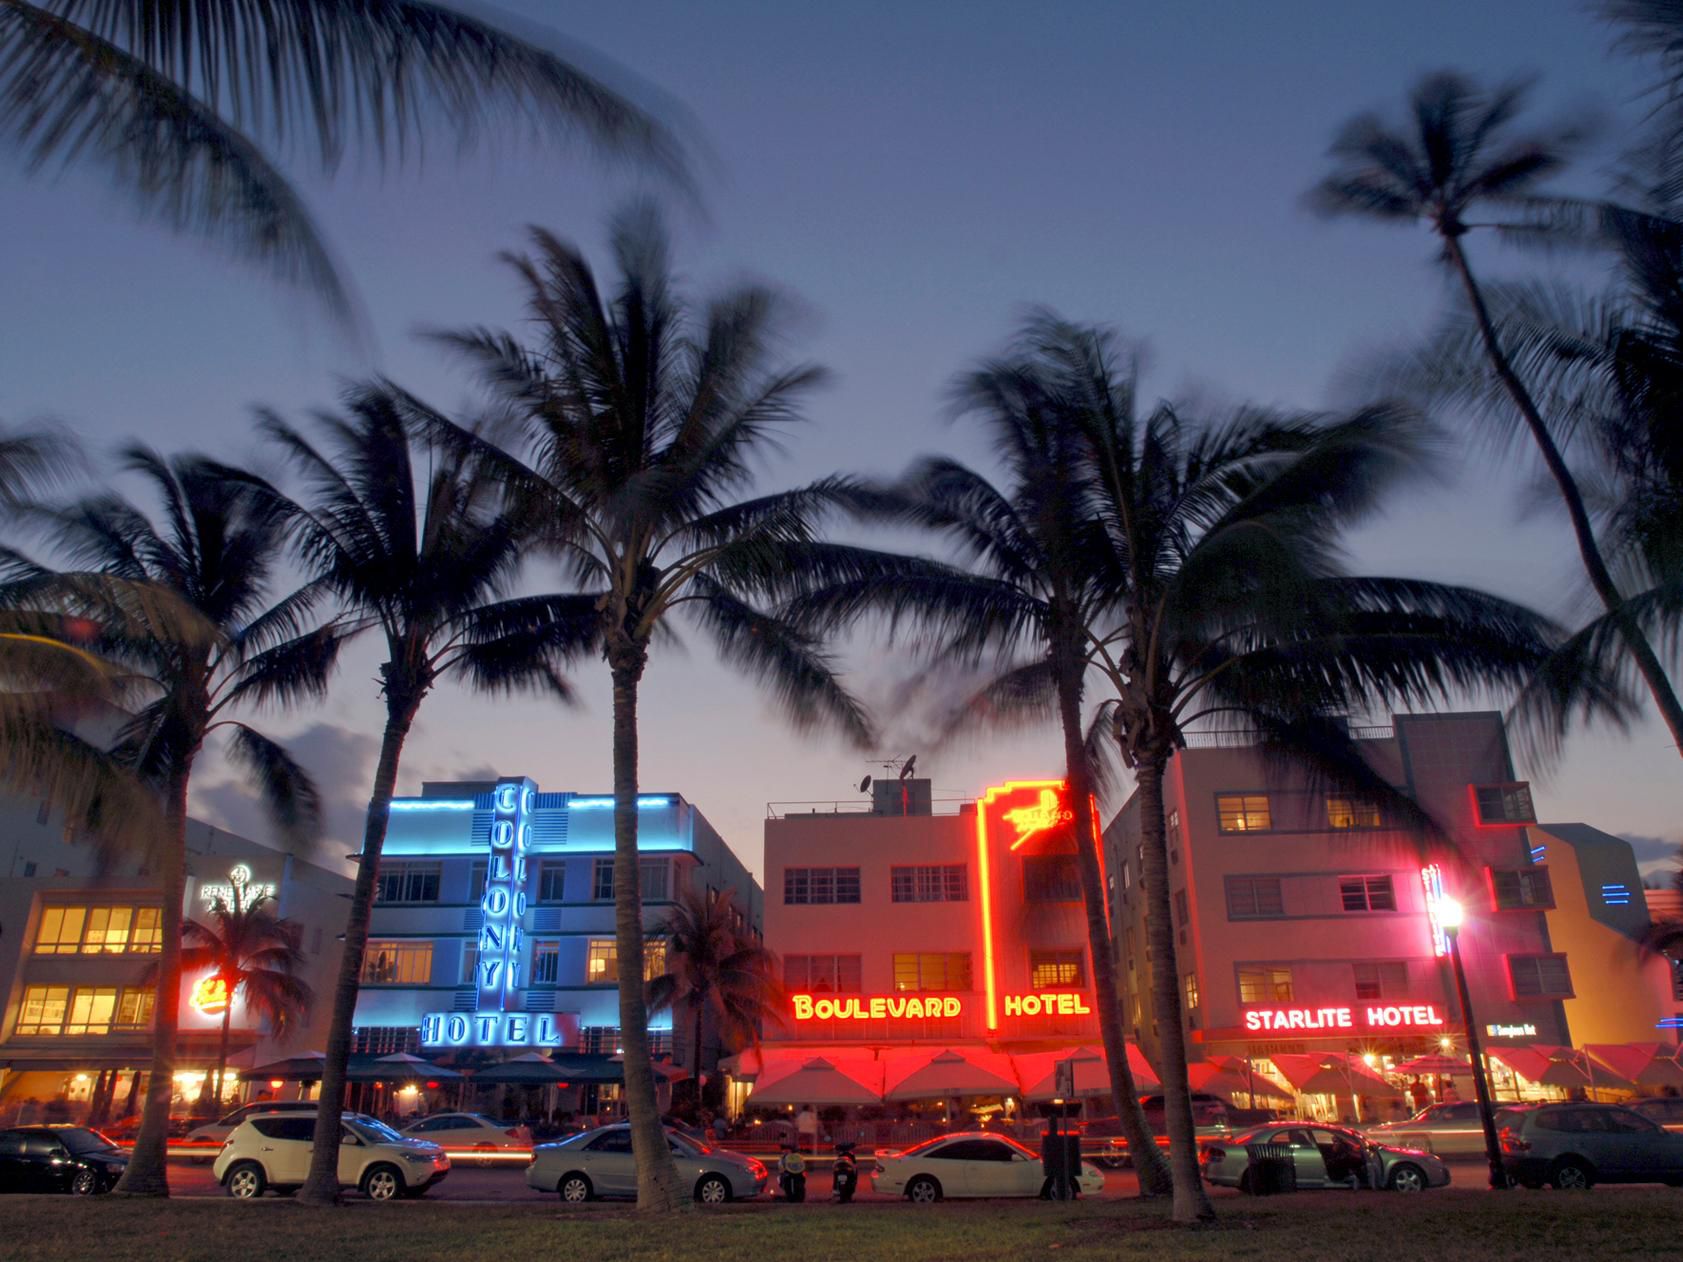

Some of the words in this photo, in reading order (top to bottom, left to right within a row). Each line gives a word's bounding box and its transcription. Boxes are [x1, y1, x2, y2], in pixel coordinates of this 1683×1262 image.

[482, 785, 517, 986] COLONY
[792, 995, 962, 1019] BOULEVARD
[1004, 994, 1091, 1016] HOTEL
[1246, 1008, 1353, 1030] STARLITE
[1367, 1006, 1443, 1026] HOTEL
[420, 1015, 561, 1043] HOTEL
